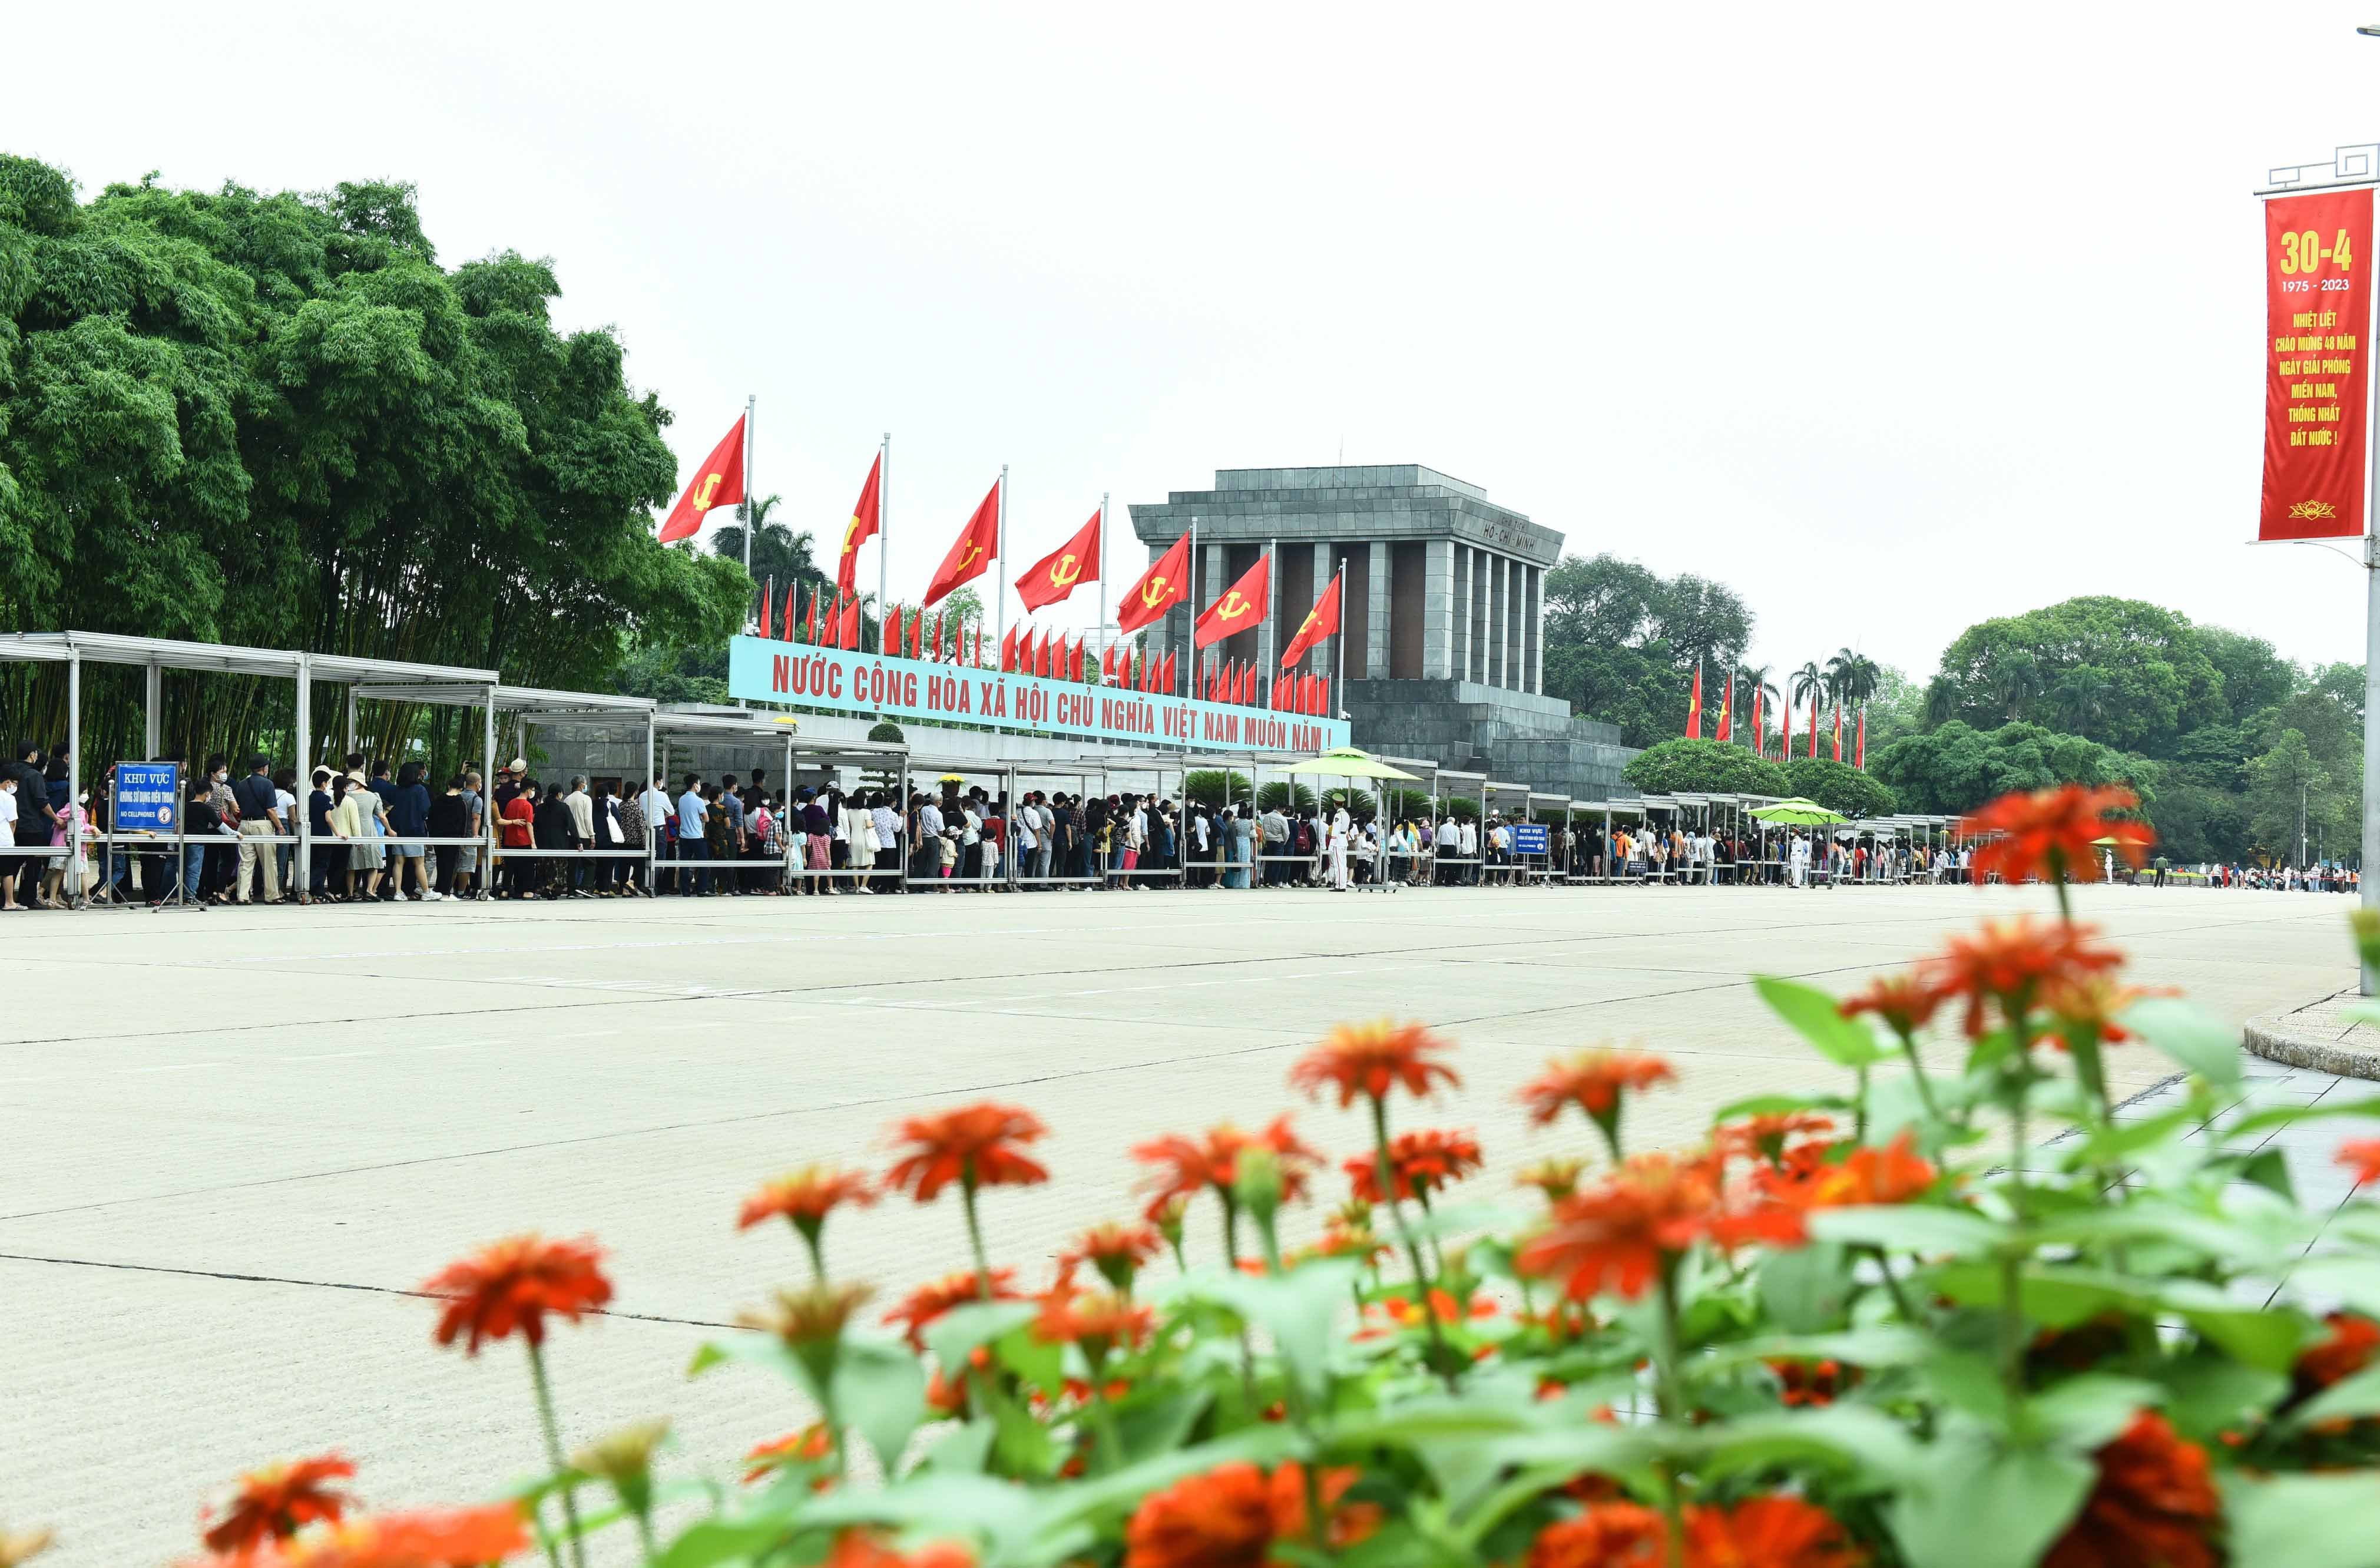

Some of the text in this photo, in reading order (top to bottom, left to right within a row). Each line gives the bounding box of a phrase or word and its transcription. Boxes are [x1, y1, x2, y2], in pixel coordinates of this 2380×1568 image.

[2280, 229, 2352, 274] 30-4
[2282, 280, 2309, 292] 1975
[2321, 279, 2349, 291] 2023
[2293, 309, 2337, 330] NHIỆT LIỆT
[2275, 332, 2356, 352] CHÀO MỪNG 48 NĂM
[2279, 353, 2351, 376] NGÀY GIẢI PHÓNG
[2315, 383, 2337, 399] NAM,
[2289, 401, 2340, 422] THỐNG NHẤT
[2290, 426, 2307, 446] ĐẤT
[2309, 426, 2332, 446] NƯỚC
[773, 652, 842, 699] NƯỚC
[854, 661, 917, 710] CỘNG
[928, 670, 971, 713] HÒA
[980, 678, 1006, 717] XÃ
[1015, 682, 1048, 727] HỘI
[1057, 687, 1094, 727] CHỦ
[1102, 696, 1154, 734] NGHĨA
[1163, 703, 1197, 743] VIỆT
[1204, 712, 1238, 743] NAM
[1244, 714, 1286, 749] MUÔN
[1292, 719, 1322, 752] NĂM
[124, 773, 170, 786] KHU VỰC
[120, 789, 133, 802] KHÔNG
